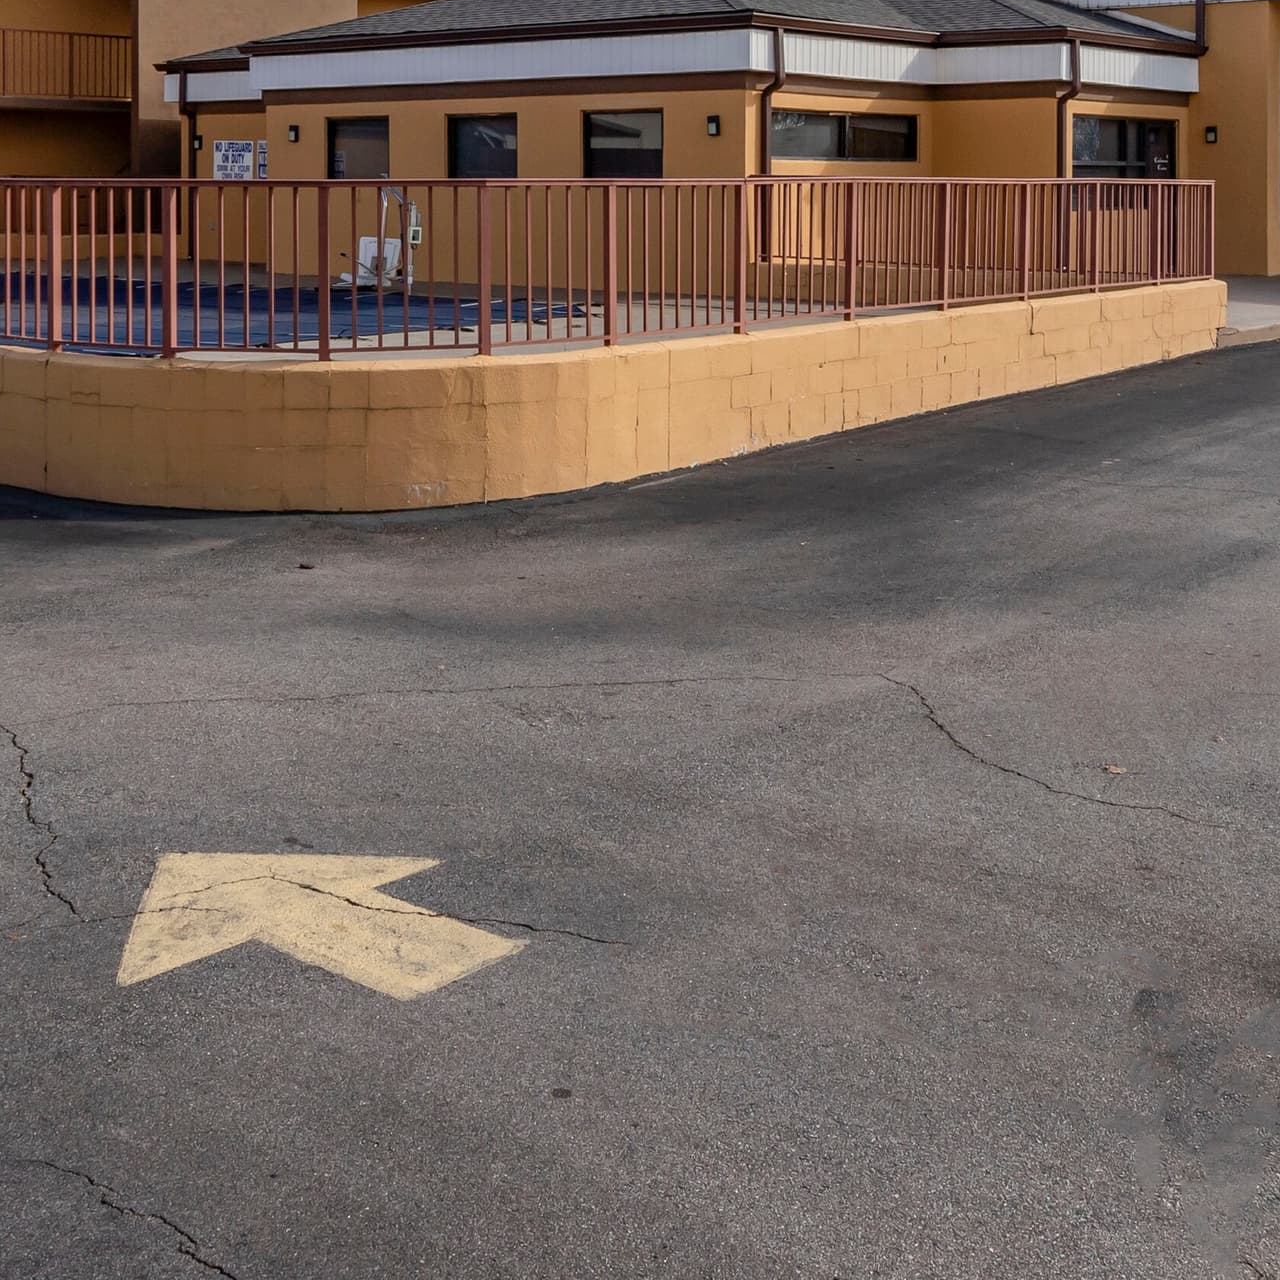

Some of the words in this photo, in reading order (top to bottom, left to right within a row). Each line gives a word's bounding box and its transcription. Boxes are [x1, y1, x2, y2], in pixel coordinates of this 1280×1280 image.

[215, 142, 223, 152] NO
[225, 142, 253, 152] LIFEGUARD
[222, 153, 230, 163] ON
[231, 153, 245, 163] DUTY
